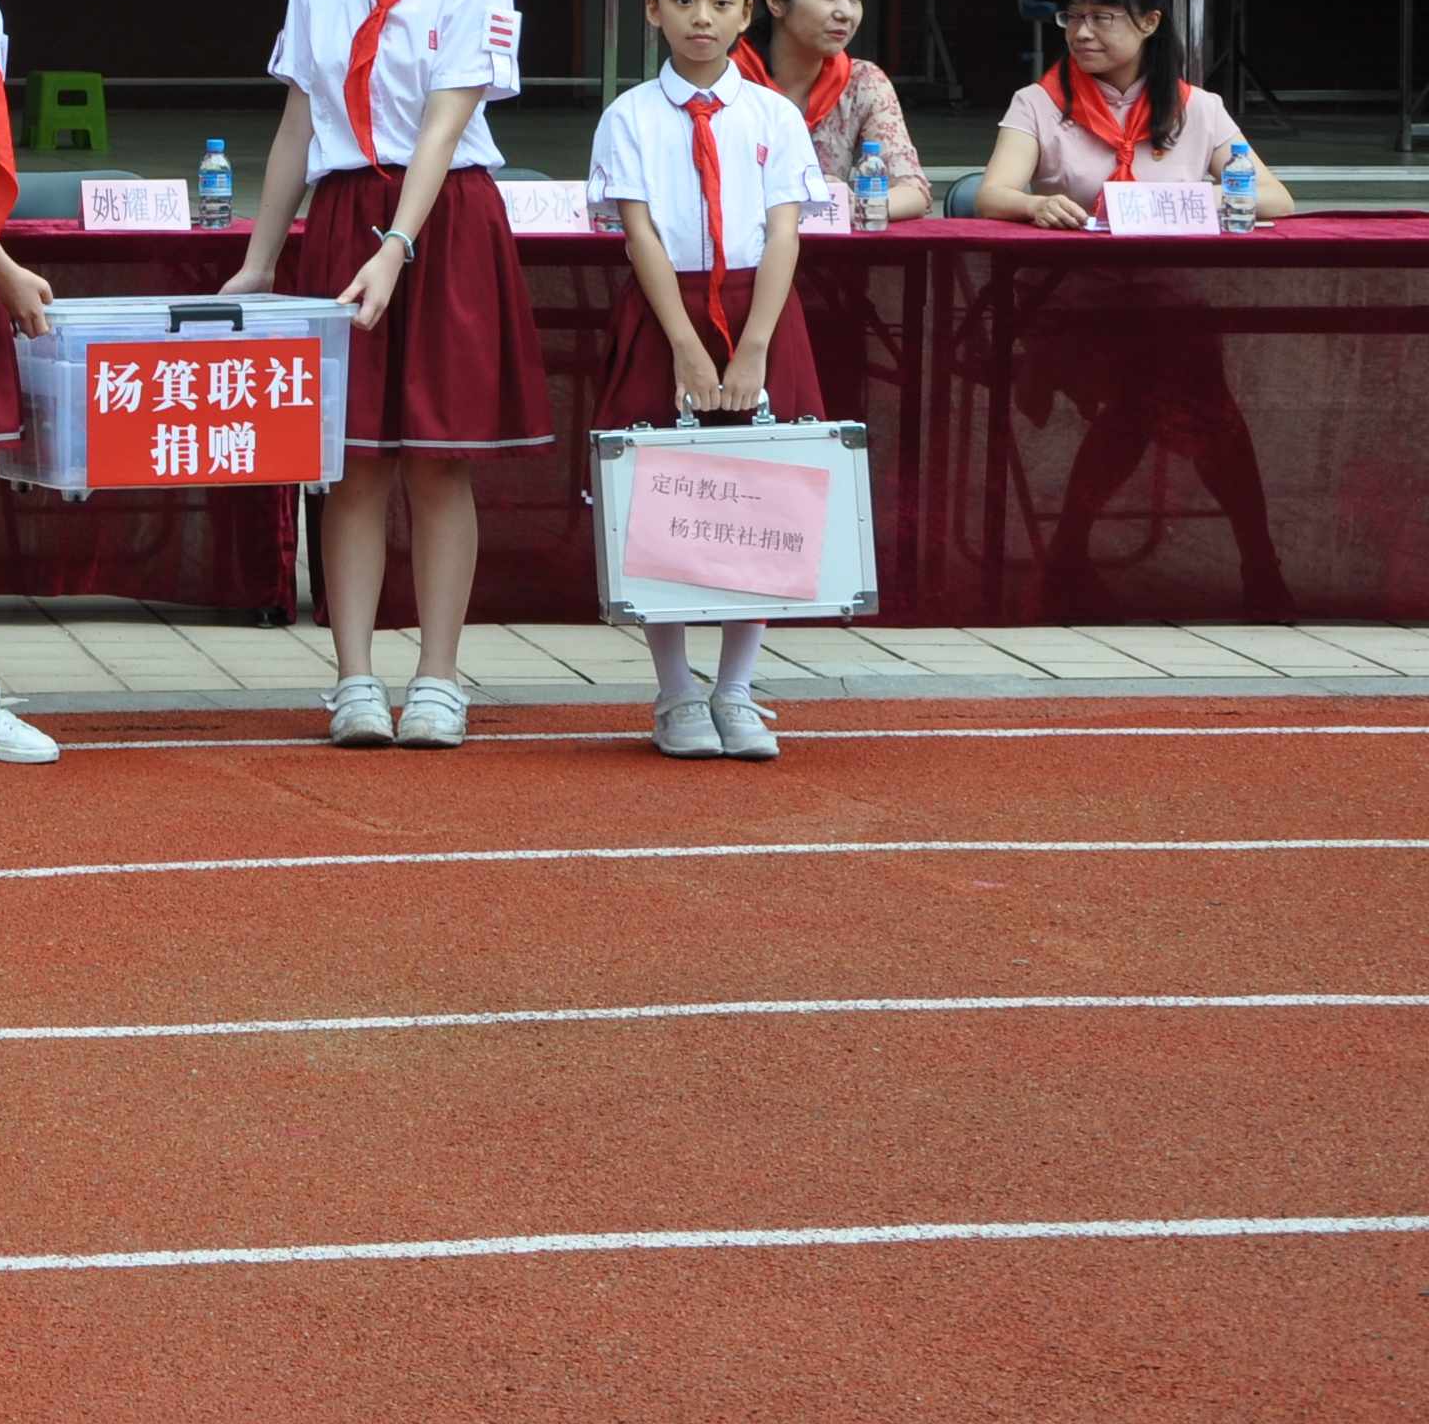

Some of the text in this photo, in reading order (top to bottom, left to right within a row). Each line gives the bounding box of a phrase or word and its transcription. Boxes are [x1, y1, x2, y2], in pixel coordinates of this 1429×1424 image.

[92, 186, 182, 224] 姚耀威
[1117, 189, 1209, 225] 陈峭梅
[93, 357, 315, 414] 杨箕联社
[150, 421, 257, 476] 捐赠
[668, 515, 805, 554] 杨箕联社捐赠
